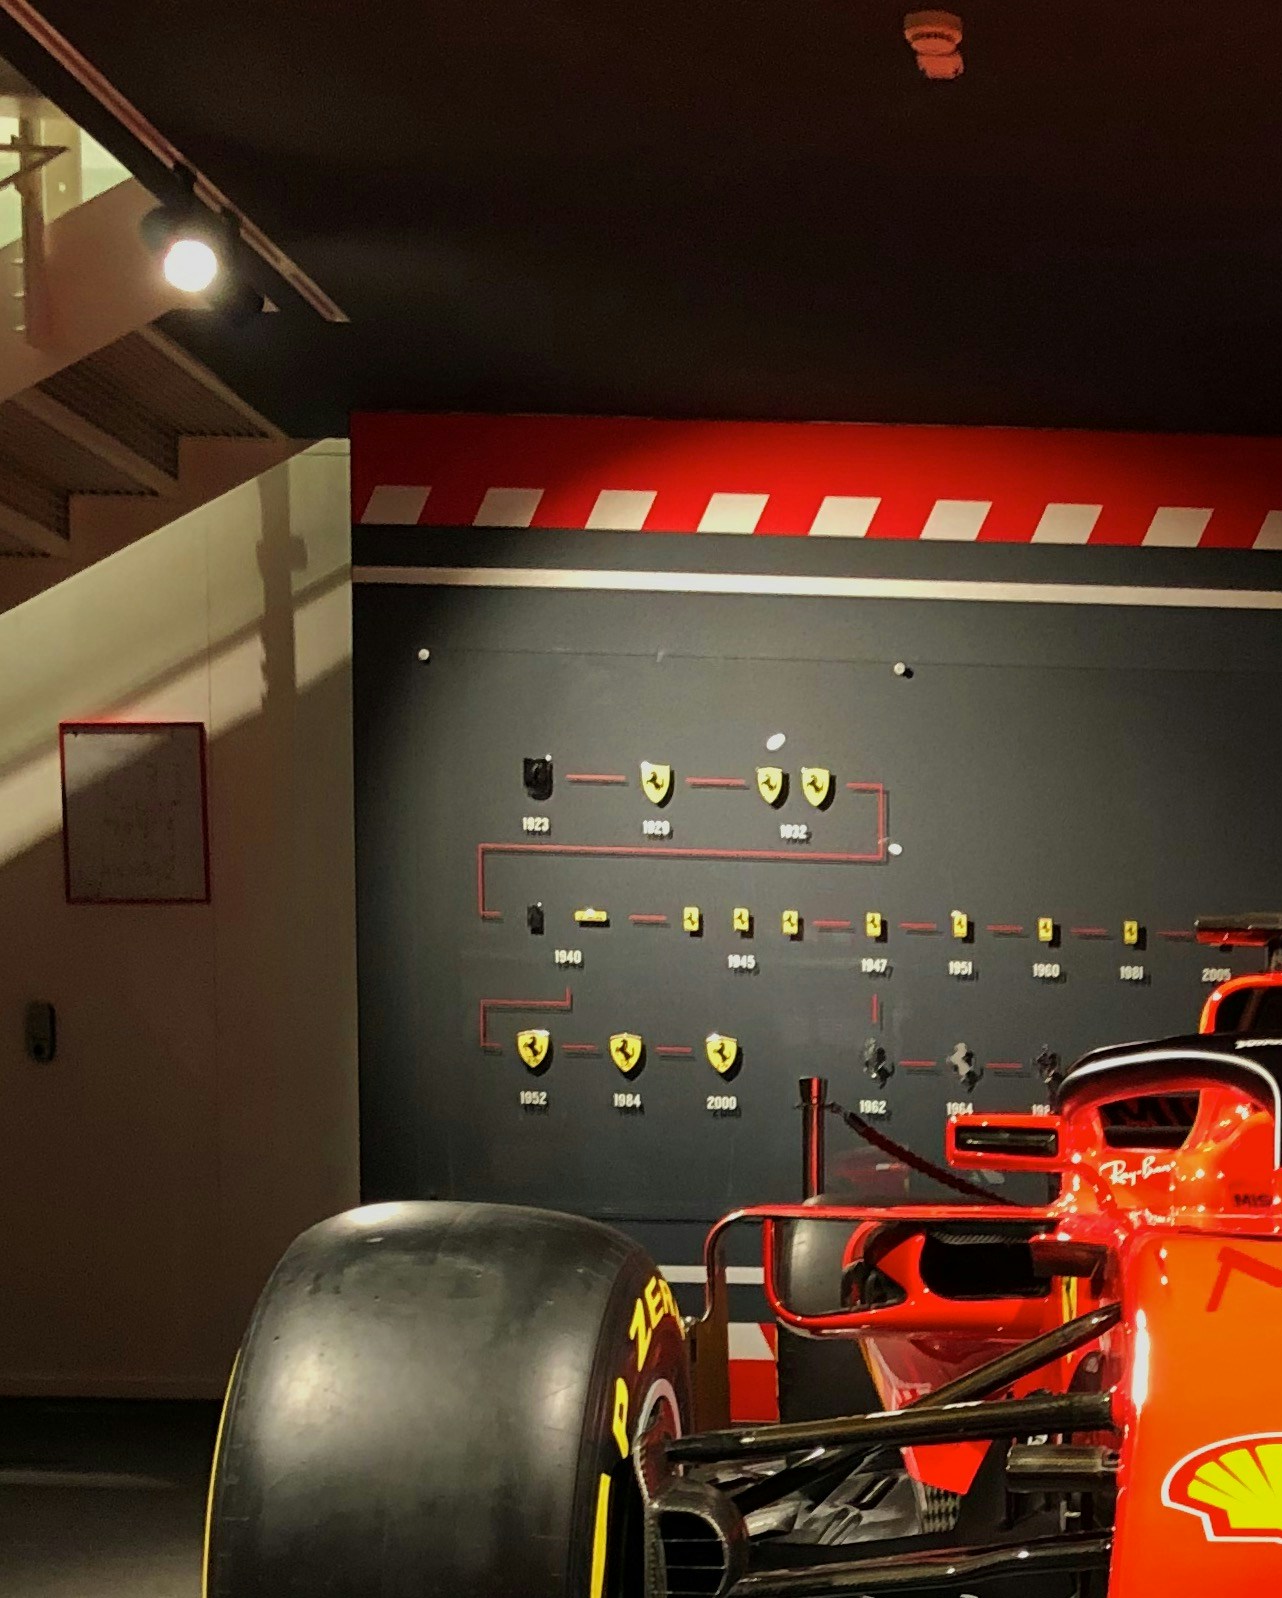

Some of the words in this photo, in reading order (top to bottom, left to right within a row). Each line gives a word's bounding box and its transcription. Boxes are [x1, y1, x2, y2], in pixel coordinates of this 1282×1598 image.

[522, 816, 550, 831] 1923
[642, 819, 670, 835] 1929
[779, 824, 808, 839] 1932
[554, 949, 582, 964] 1940
[727, 954, 756, 969] 1945
[861, 958, 888, 973] 1947
[948, 960, 973, 975] 1951
[520, 1091, 548, 1105] 1952
[613, 1093, 641, 1108] 1984
[706, 1095, 738, 1110] 2000
[859, 1099, 887, 1114] 1962
[1098, 1155, 1172, 1187] Ray-Ban
